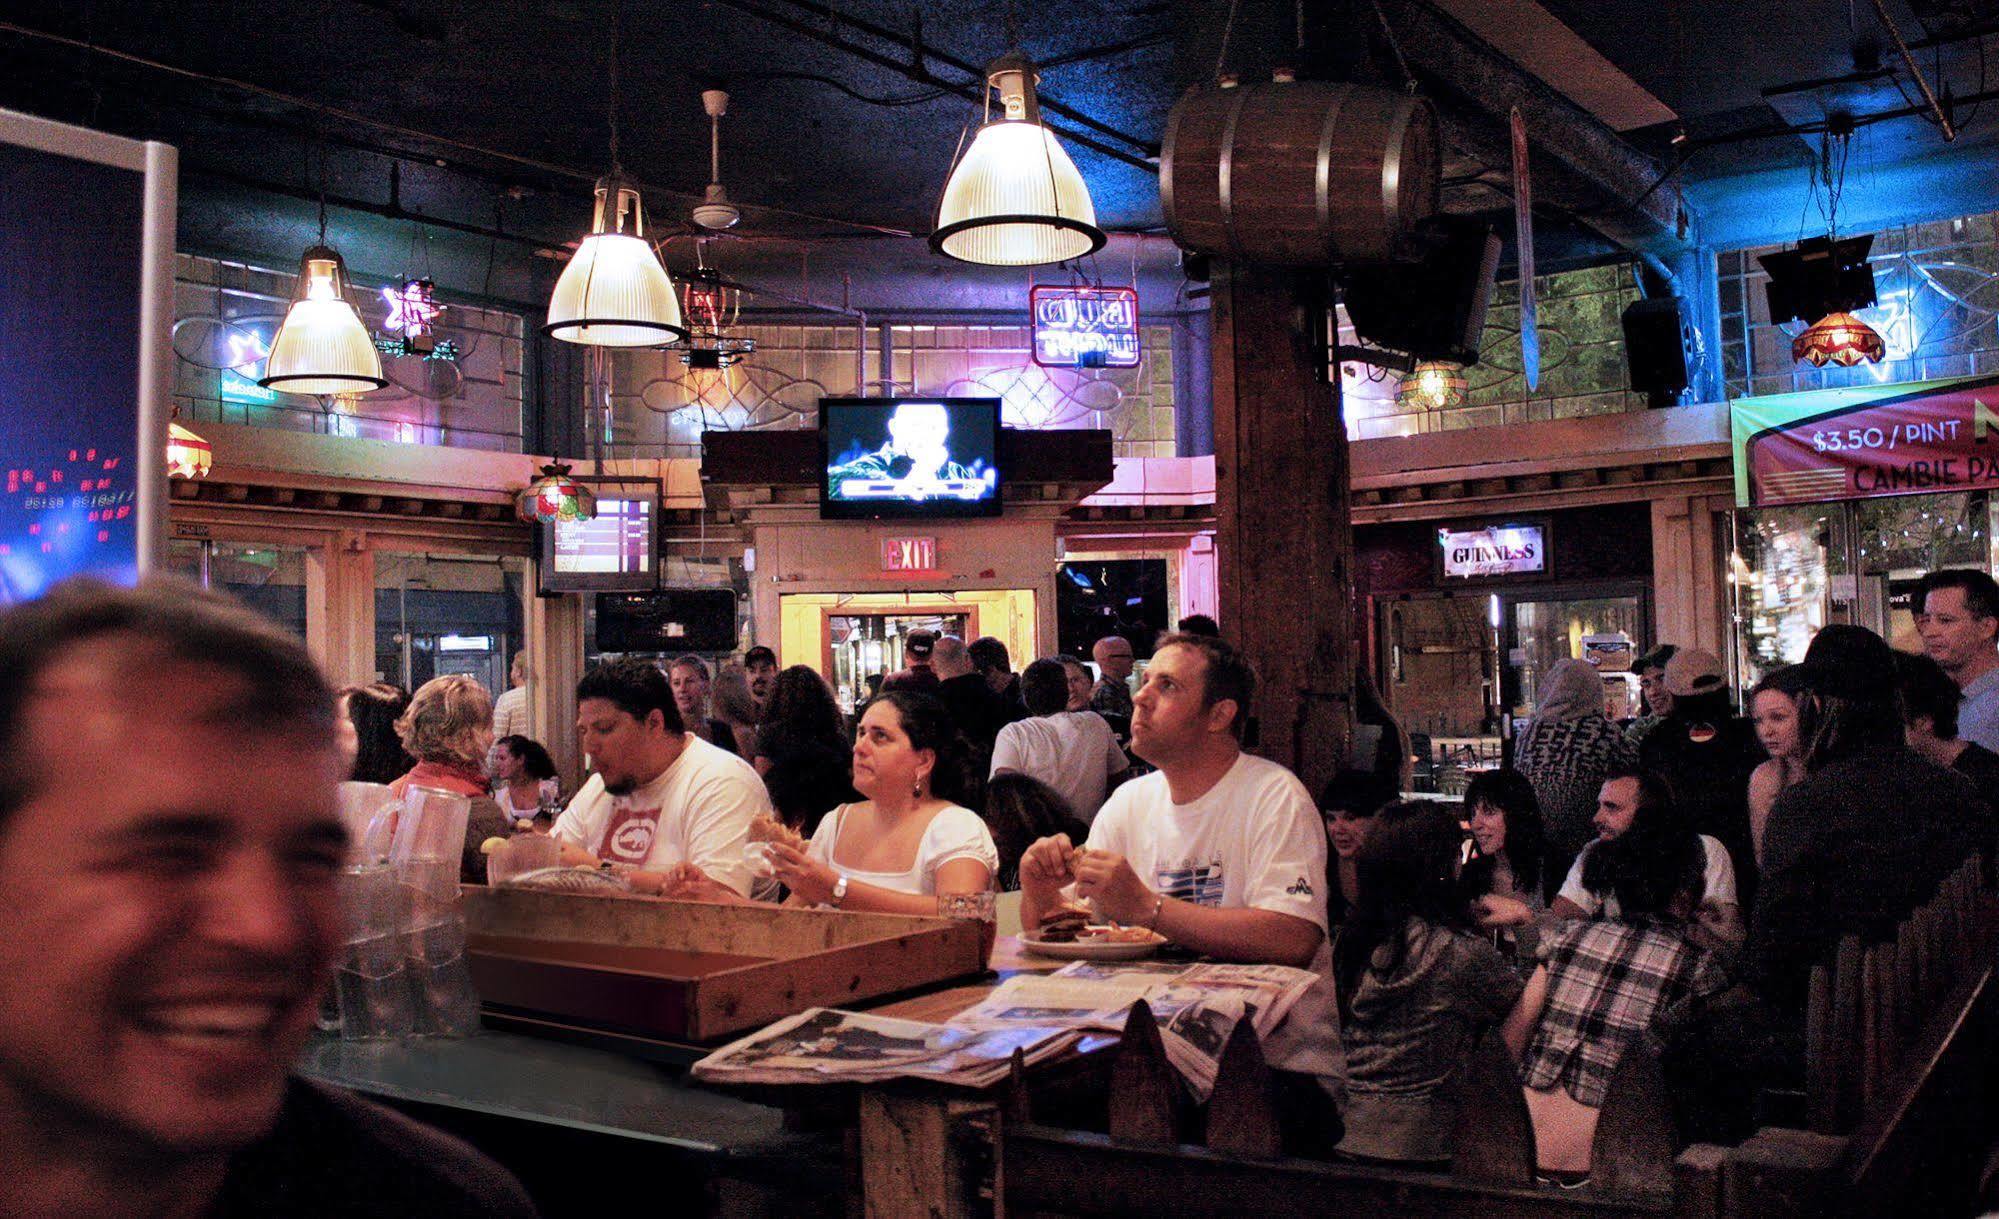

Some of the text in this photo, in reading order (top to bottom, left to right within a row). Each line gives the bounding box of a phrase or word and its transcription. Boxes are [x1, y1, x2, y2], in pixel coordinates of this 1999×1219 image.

[1813, 426, 1884, 453] $3.50
[1905, 420, 1961, 444] PINT
[1854, 458, 1958, 492] CAMBIE
[887, 540, 931, 570] EXIT
[1452, 543, 1535, 564] GUINNESS
